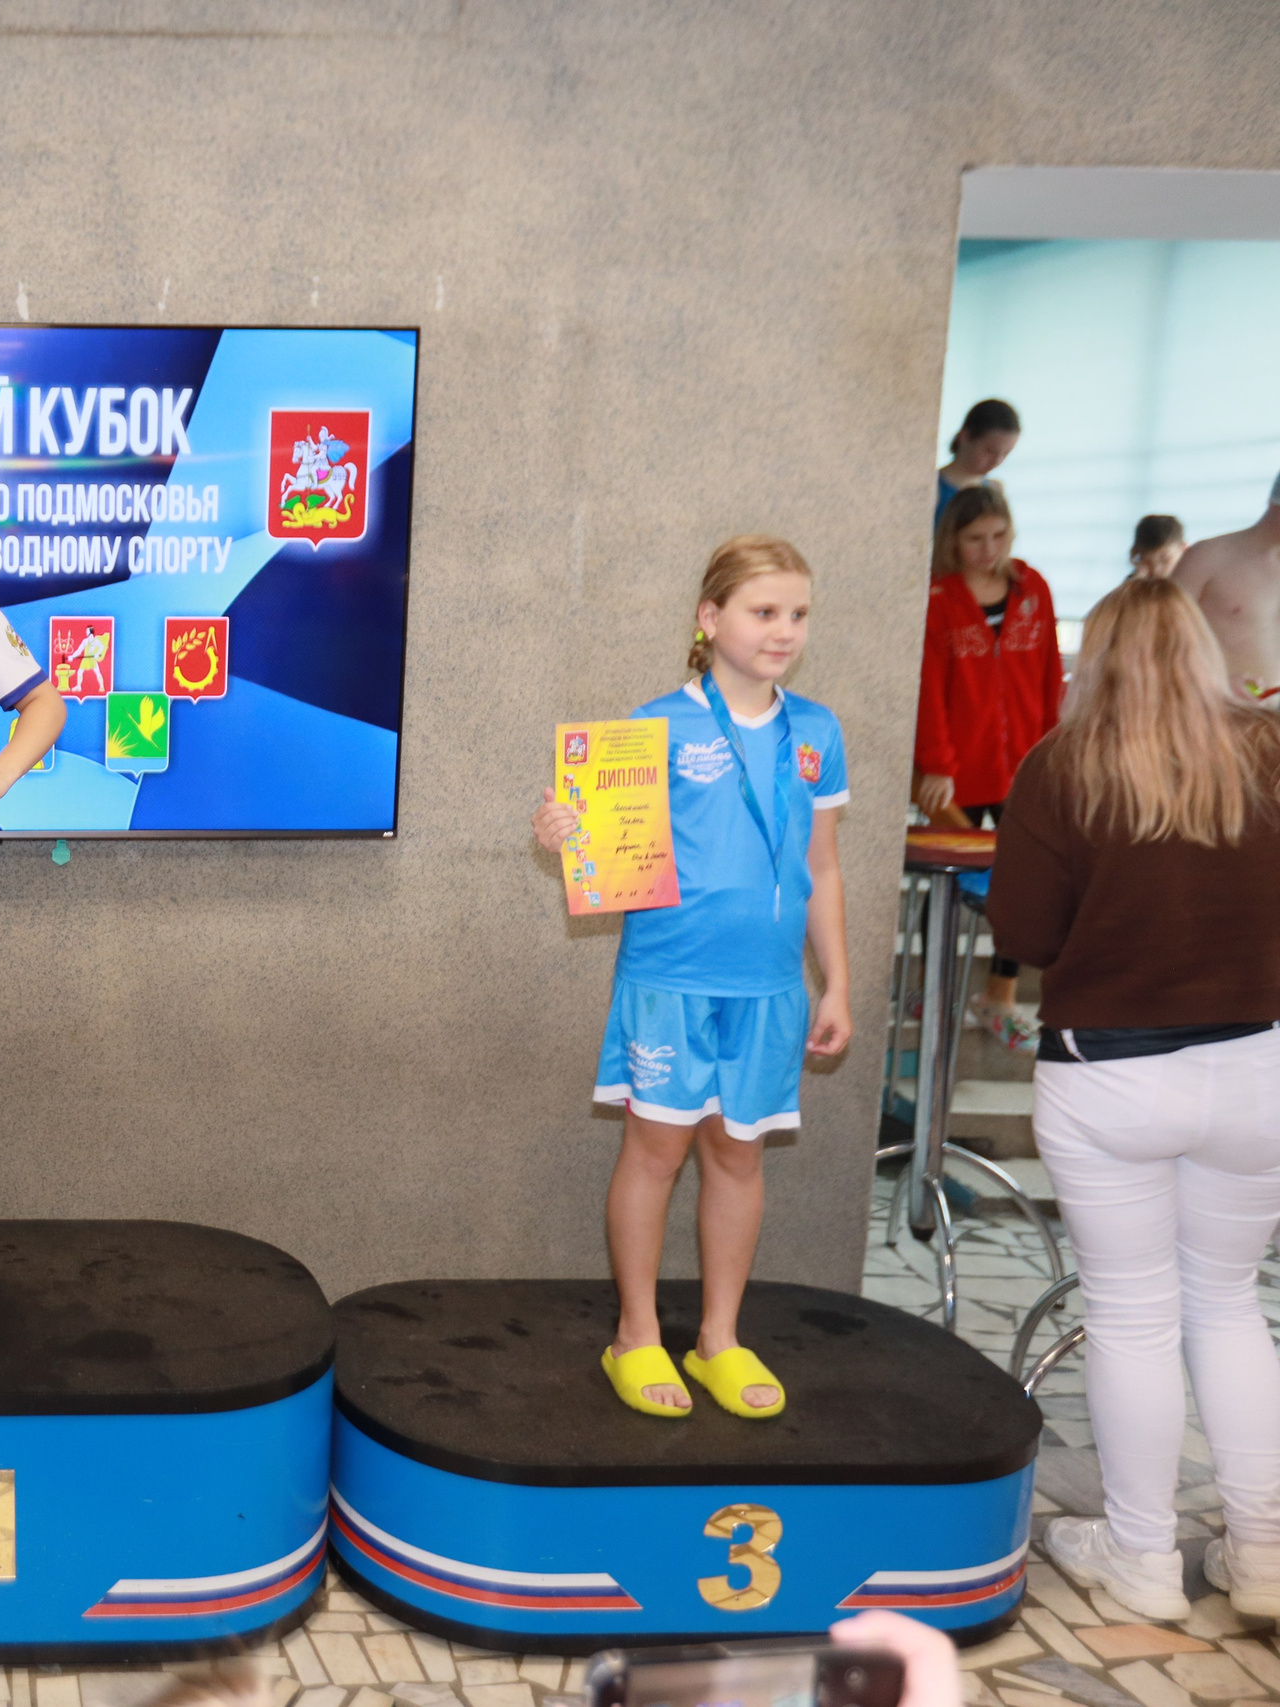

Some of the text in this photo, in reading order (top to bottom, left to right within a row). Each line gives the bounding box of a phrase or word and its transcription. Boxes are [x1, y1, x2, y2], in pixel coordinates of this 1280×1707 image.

[29, 387, 194, 455] КУБОК
[17, 484, 219, 526] ПОДМОСКОВЬЯ
[127, 536, 233, 574] СПОРТУ
[596, 766, 657, 791] ДИПЛОМ
[697, 1503, 783, 1611] 3
